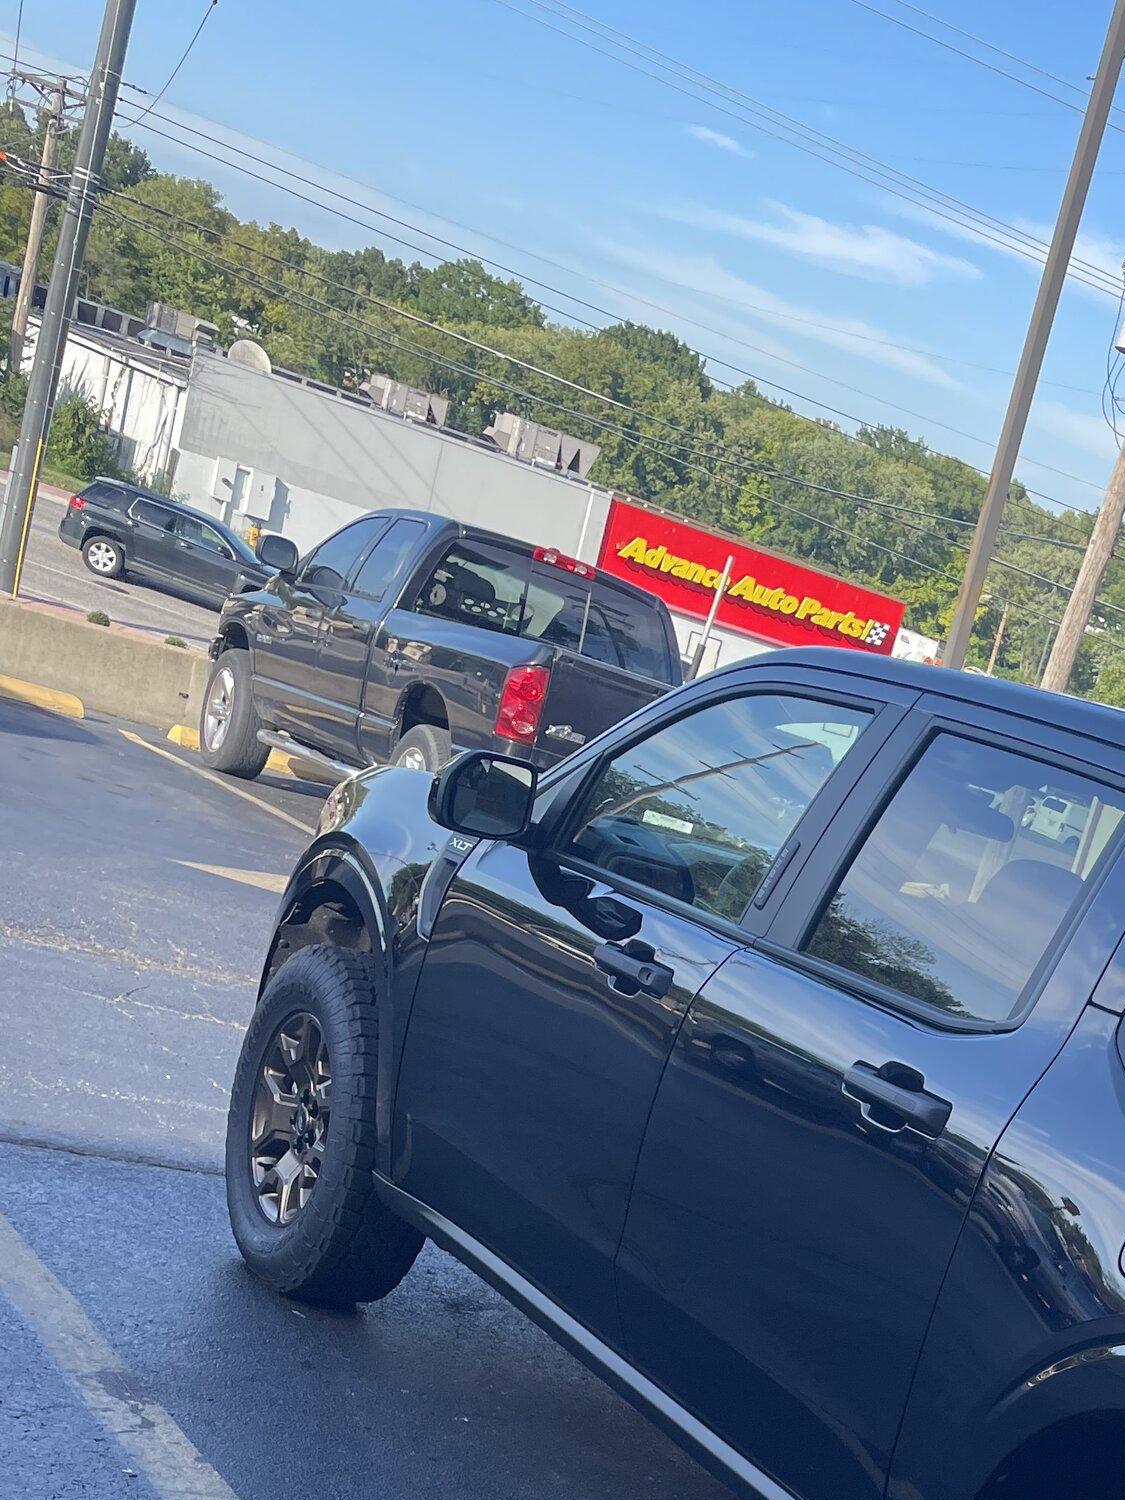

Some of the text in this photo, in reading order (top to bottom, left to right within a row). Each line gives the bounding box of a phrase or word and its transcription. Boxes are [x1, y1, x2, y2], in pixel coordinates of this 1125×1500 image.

[617, 537, 866, 638] Advance Auto Parts
[449, 837, 474, 851] XLT
